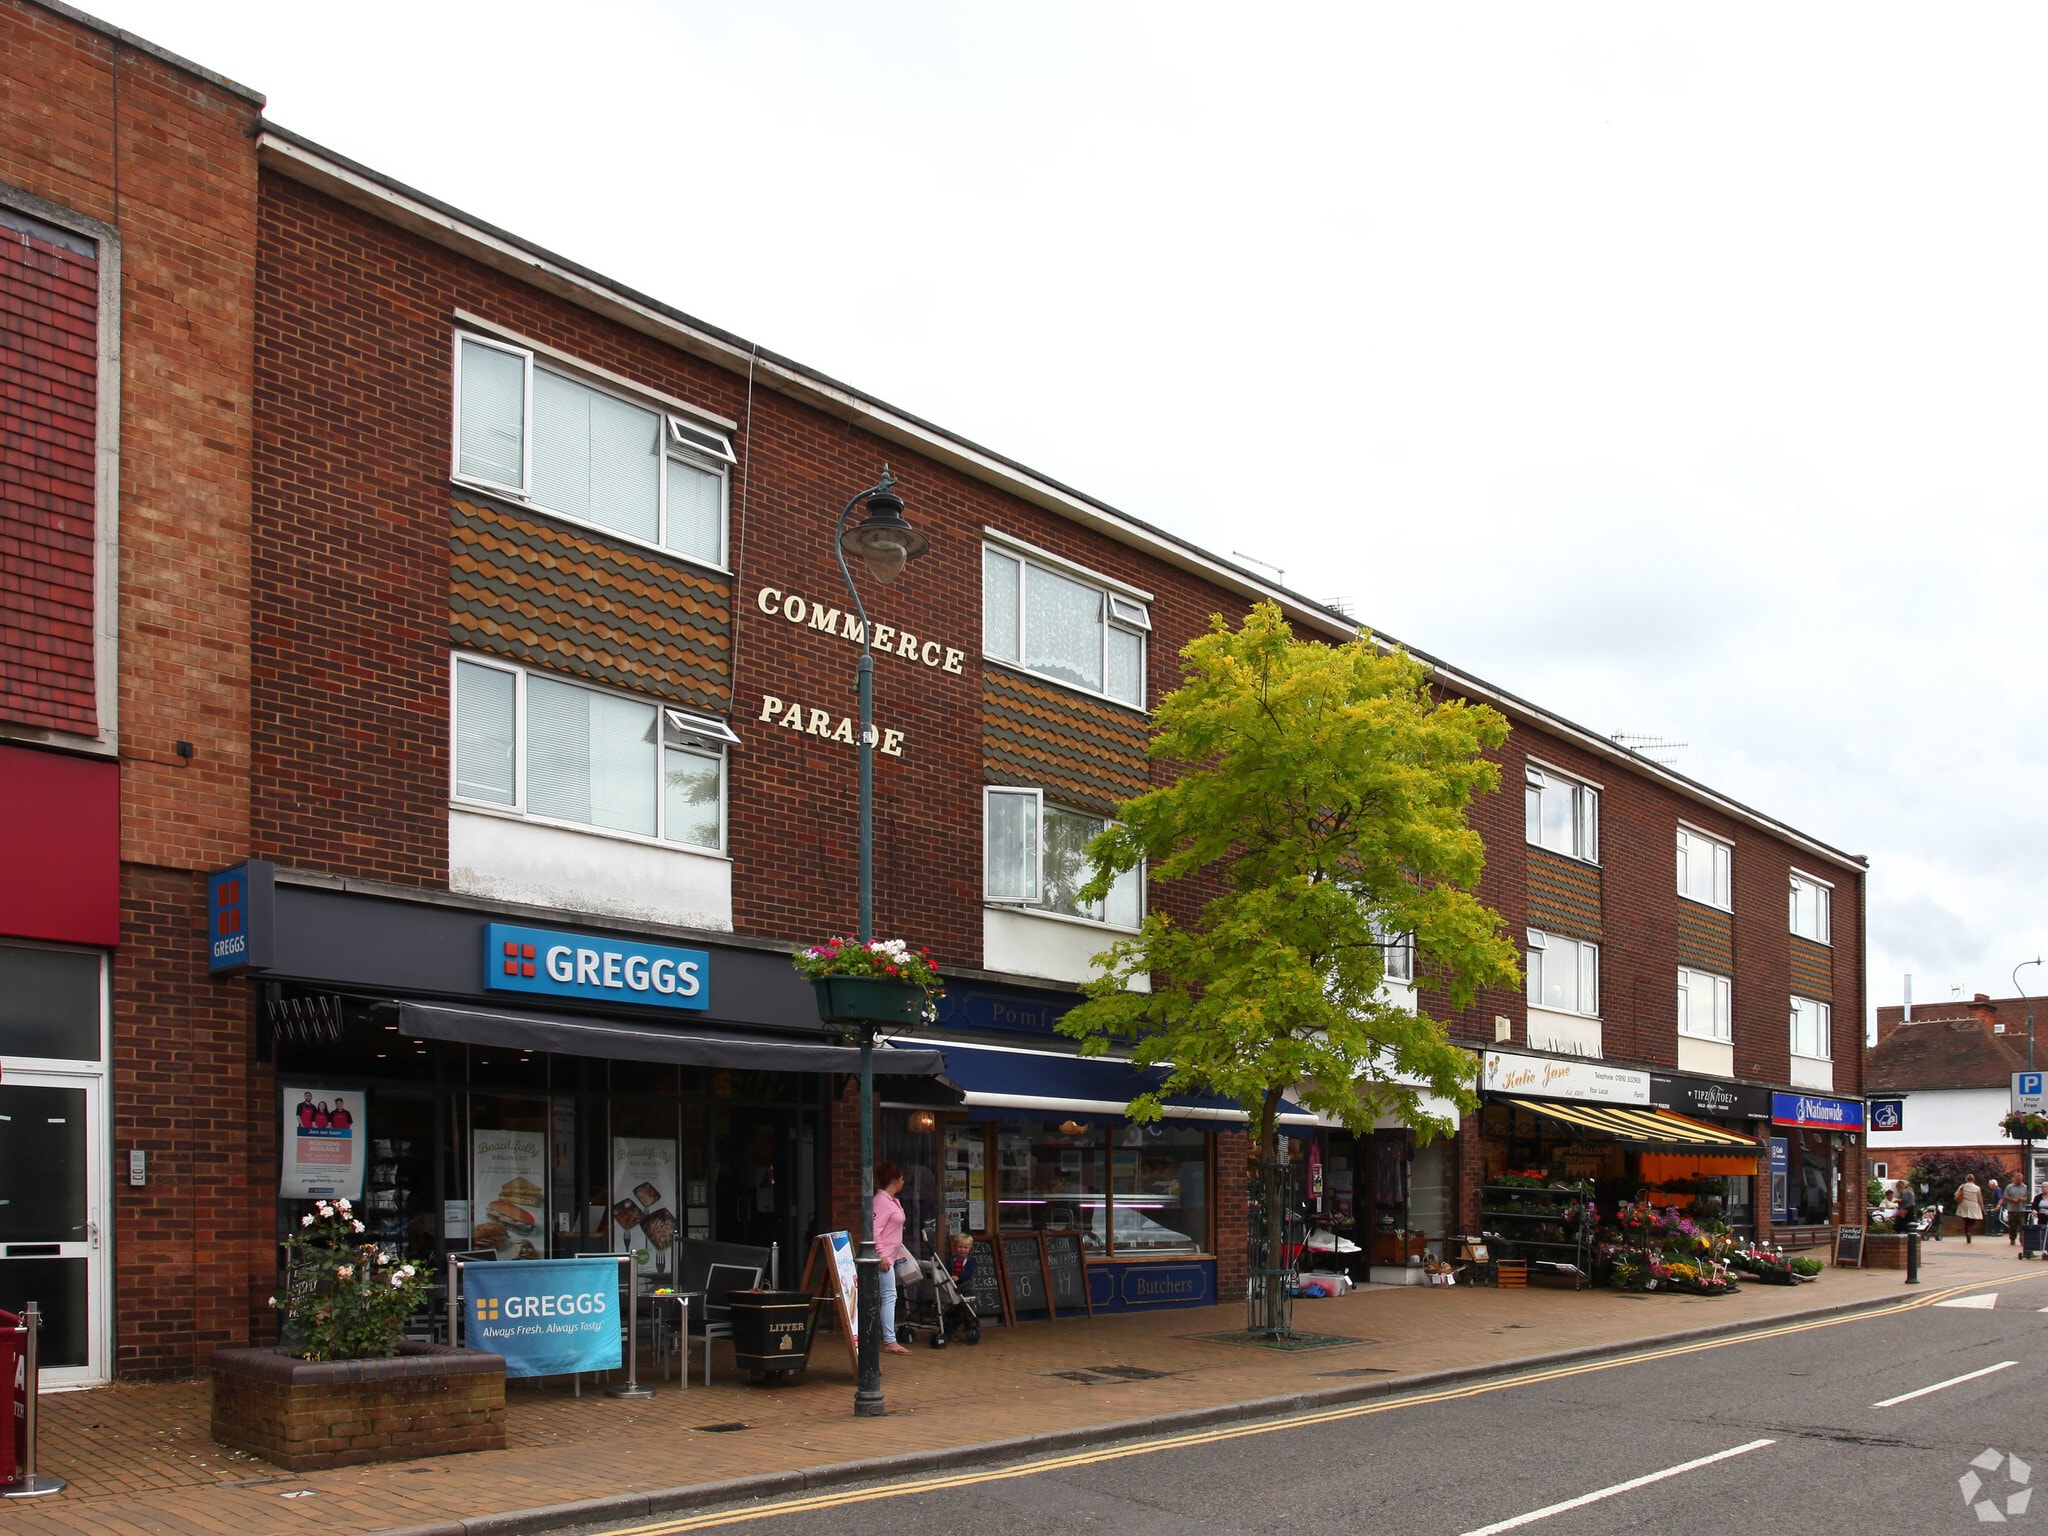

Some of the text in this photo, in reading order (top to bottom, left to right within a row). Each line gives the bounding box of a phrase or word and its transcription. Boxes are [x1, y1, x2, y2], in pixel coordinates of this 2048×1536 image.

[758, 587, 964, 674] COMMERCE
[214, 935, 245, 957] GREGGS
[546, 945, 700, 997] GREGGS
[1502, 1061, 1571, 1089] Katie Jane
[2024, 1075, 2039, 1093] P
[1589, 1086, 1598, 1094] Your
[1598, 1087, 1609, 1095] Local
[1633, 1090, 1645, 1099] Florist
[1694, 1089, 1708, 1100] TIPZ
[1717, 1092, 1733, 1103] TOEZ
[1806, 1100, 1843, 1121] Nationwide
[478, 1140, 539, 1158] Beautifully
[491, 1154, 528, 1162] BALANCED
[617, 1147, 671, 1164] Beautifully
[1137, 1275, 1193, 1295] Butchers
[504, 1292, 607, 1319] GREGGS
[482, 1327, 515, 1339] Always
[516, 1325, 545, 1335] Fresh.
[546, 1323, 579, 1336] Always
[769, 1322, 805, 1332] LITTER
